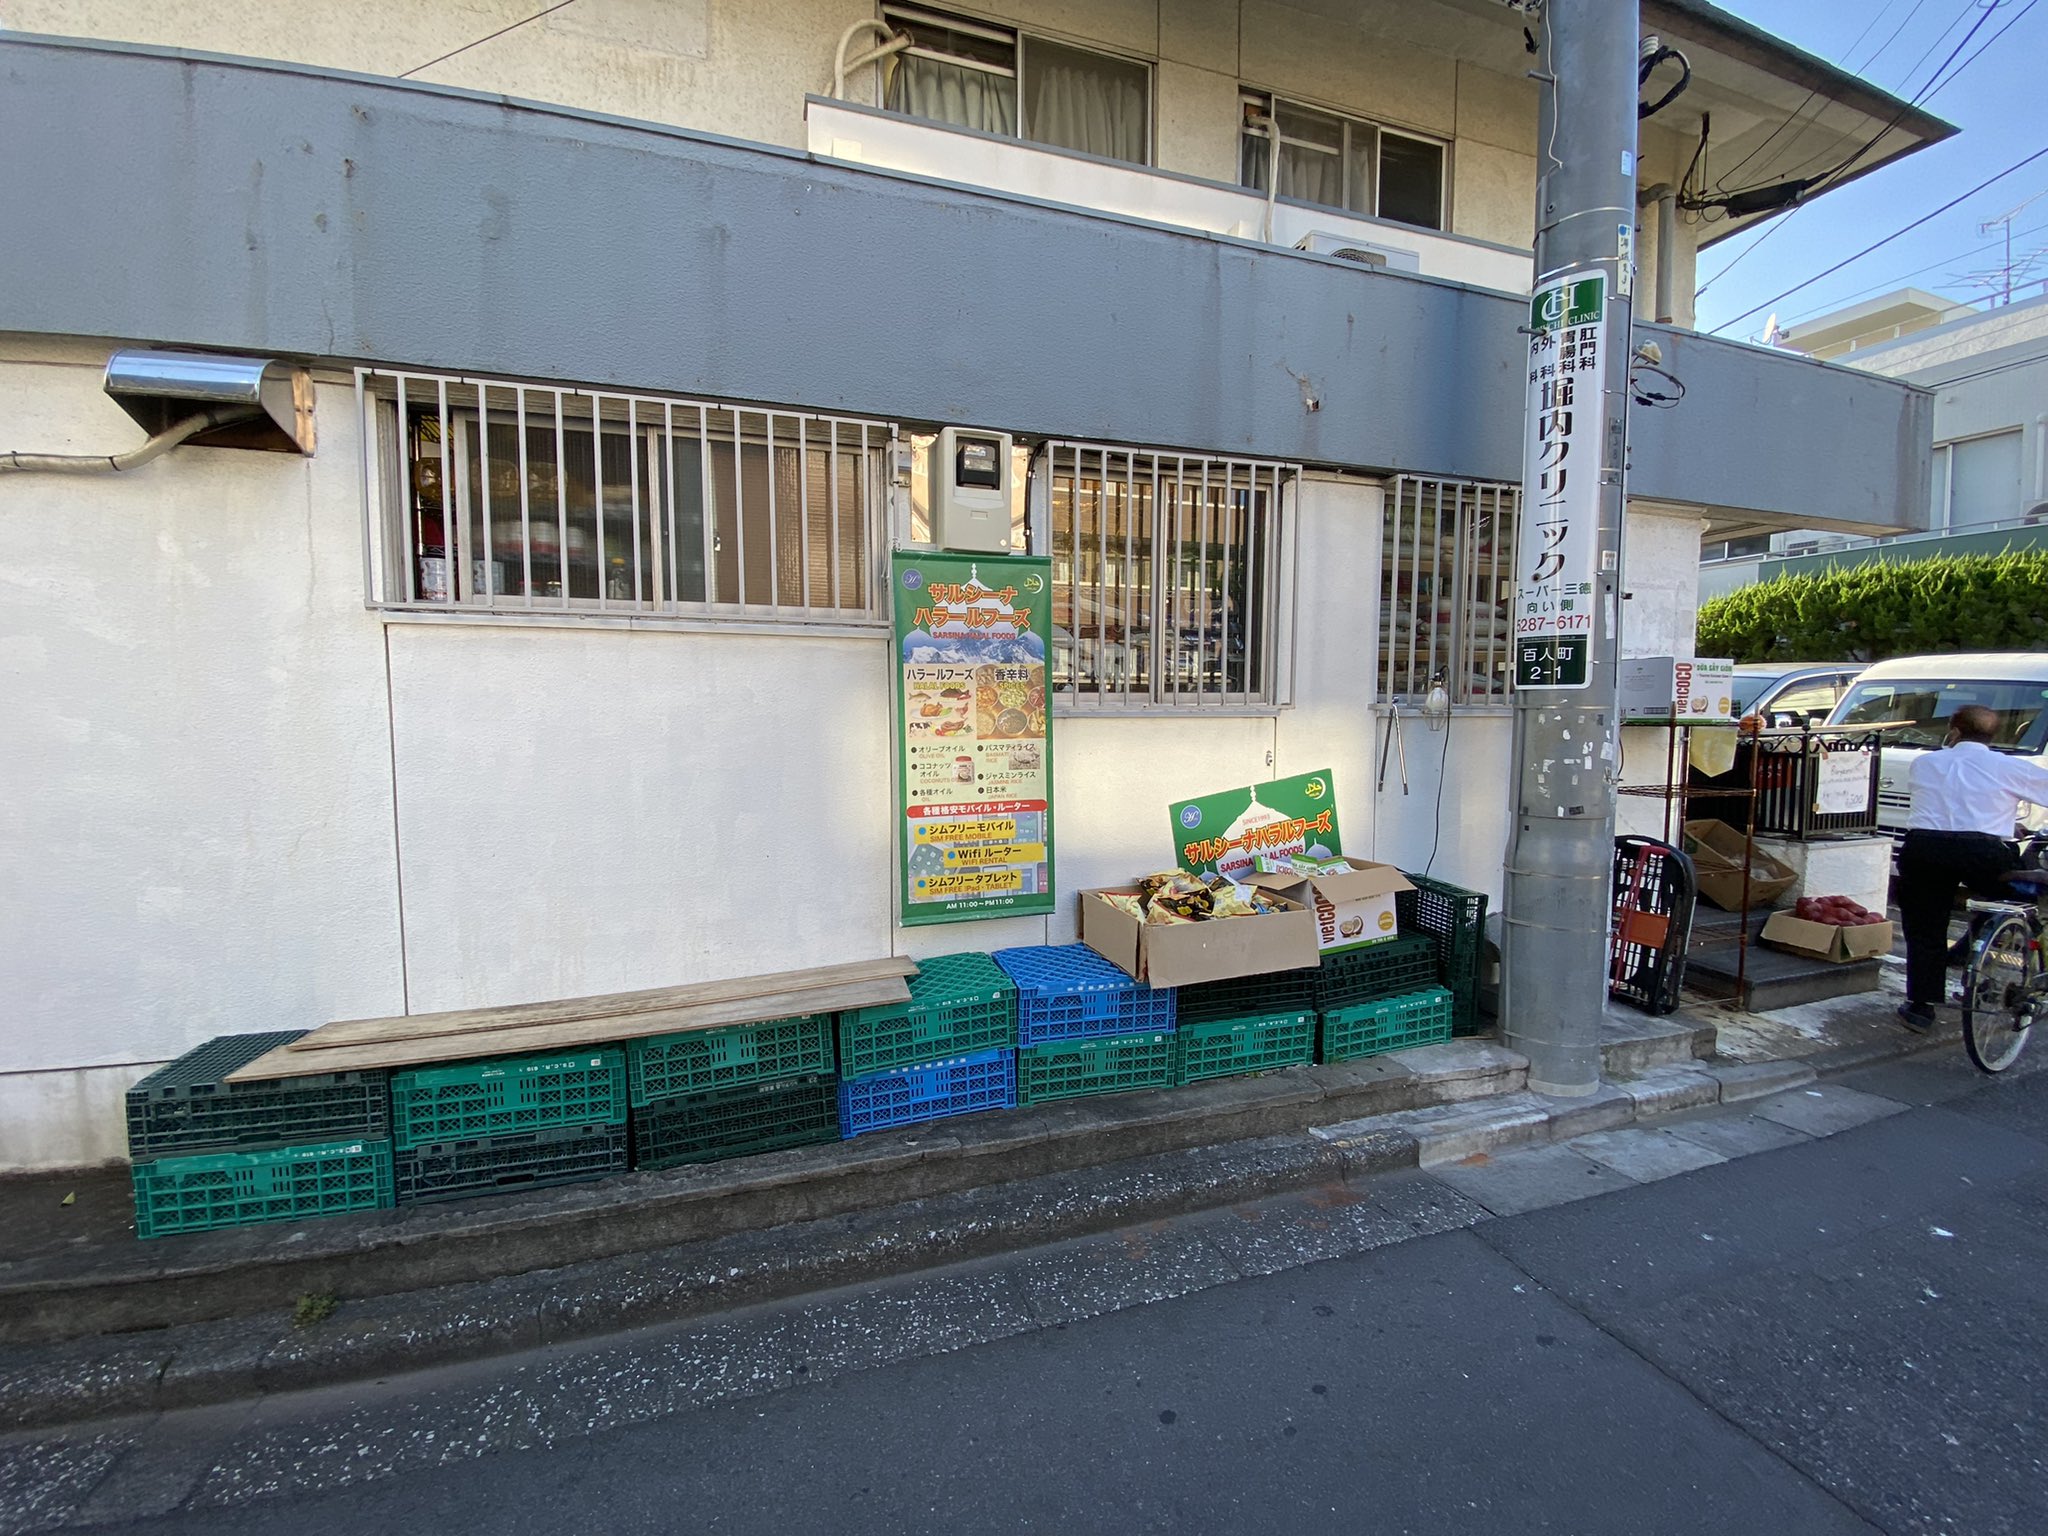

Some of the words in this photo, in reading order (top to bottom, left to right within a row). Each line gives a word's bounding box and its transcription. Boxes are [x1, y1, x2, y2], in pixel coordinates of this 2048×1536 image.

[1568, 311, 1600, 325] CLINIC
[1559, 330, 1576, 374] 胃腸科
[1579, 326, 1597, 371] 肛門科
[1540, 335, 1556, 379] 外科
[1535, 377, 1574, 581] 堀内クリニック
[928, 583, 1018, 606] サルシーナ
[1518, 582, 1592, 600] スーパー三徳
[1527, 599, 1574, 614] 向い側
[913, 606, 1031, 629] ハラールフーズ
[933, 632, 965, 640] SARSINA
[992, 632, 1016, 640] FOODS
[1523, 647, 1574, 661] 百人町
[907, 669, 973, 680] ハラールフーズ
[995, 669, 1028, 680] 香辛料
[1530, 666, 1561, 679] 2-1
[914, 682, 938, 690] HALAL
[939, 682, 966, 690] FOODS
[1000, 682, 1025, 690] SPICES
[919, 745, 965, 753] オリーブオイル
[985, 744, 1036, 752] バスマティライス
[986, 771, 1036, 779] ジャスミンライス
[920, 788, 953, 796] 各種オイル
[986, 786, 1007, 794] 日本米
[923, 802, 1030, 816] 各種格安モバイル・ルーター
[930, 821, 1014, 835] シムフリーモバイル
[930, 835, 944, 843] SIM
[945, 834, 963, 842] FREE
[965, 832, 993, 840] MOBILE
[1184, 809, 1333, 865] サルシーナハラルフーズ
[958, 849, 981, 859] Wifi
[984, 847, 1022, 858] ルーター
[1220, 857, 1253, 872] SARSINA
[1279, 845, 1304, 859] FOODS
[980, 857, 1007, 865] RENTAL
[929, 872, 1017, 888] シムフリータブレット
[930, 887, 943, 895] SIM
[944, 886, 964, 894] FREE
[986, 882, 1013, 890] TABLET
